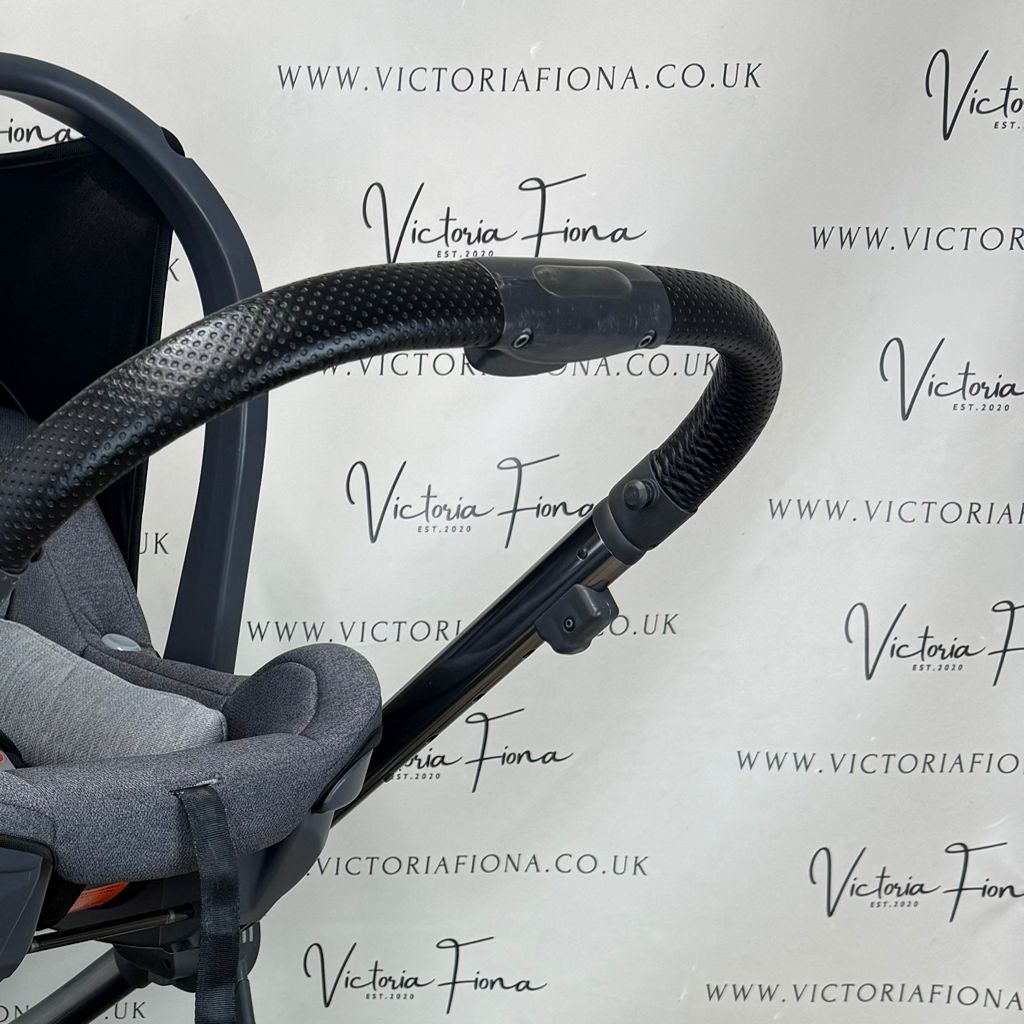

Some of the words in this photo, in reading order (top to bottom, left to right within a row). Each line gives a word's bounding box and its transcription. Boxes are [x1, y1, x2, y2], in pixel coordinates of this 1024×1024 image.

[277, 62, 764, 93] WWW.VICTORIAFIONA.CO.UK
[362, 182, 518, 264] Victoria
[518, 173, 647, 259] Fiona
[812, 225, 1024, 252] WWW.VICTOR
[879, 336, 1024, 422] Victoria
[952, 402, 1011, 412] EST.2020
[346, 460, 495, 544] Victoria
[417, 524, 472, 534] EST.2020
[844, 602, 986, 681] Victoria
[912, 663, 964, 672] EST.2020
[465, 708, 575, 794] Fiona
[736, 750, 1024, 775] WWW.VICTORIAFIO
[809, 846, 941, 918] Victoria
[870, 900, 919, 909] EST.2020
[303, 942, 435, 1008] Victoria
[436, 936, 548, 1015] Fiona
[365, 992, 415, 1000] EST.2020
[706, 983, 1024, 1011] WWW.VICTORIAFIONA
